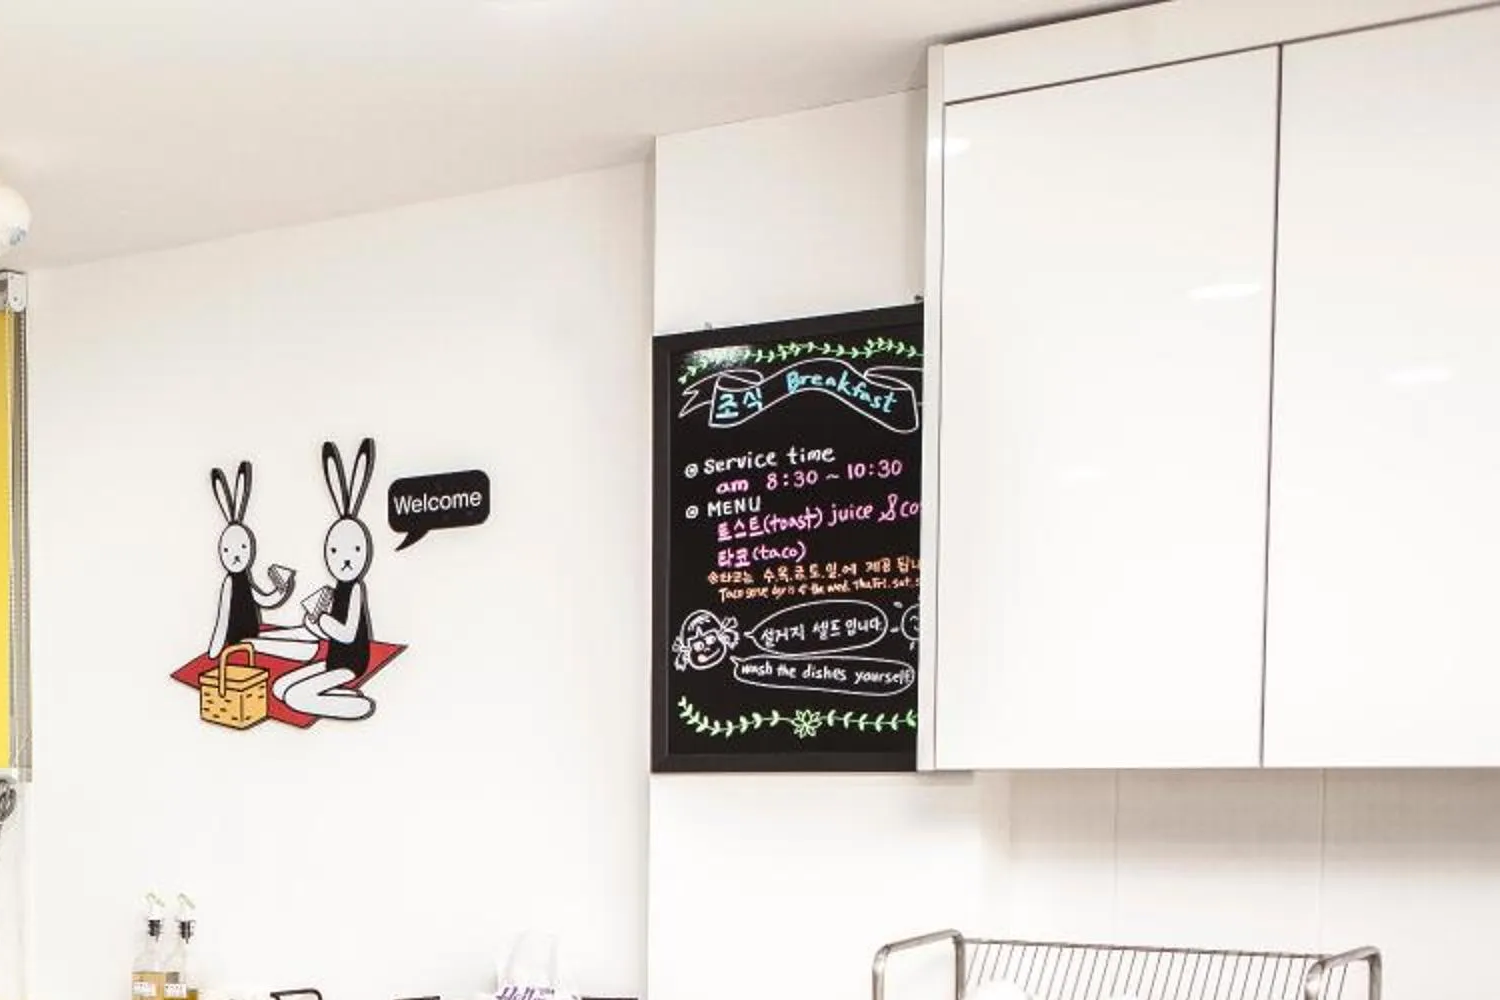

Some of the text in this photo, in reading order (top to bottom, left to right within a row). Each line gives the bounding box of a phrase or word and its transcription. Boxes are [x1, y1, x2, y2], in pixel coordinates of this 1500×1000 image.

[715, 387, 763, 419] 조식
[784, 370, 898, 414] Breakfast
[787, 447, 836, 465] time
[716, 478, 749, 494] am
[766, 470, 819, 492] 8:30
[847, 460, 903, 480] 10:30
[393, 491, 483, 515] Welcome
[707, 496, 762, 518] MENU
[827, 503, 874, 527] juice
[741, 660, 773, 676] wash
[777, 663, 796, 678] the
[802, 664, 847, 681] dishes
